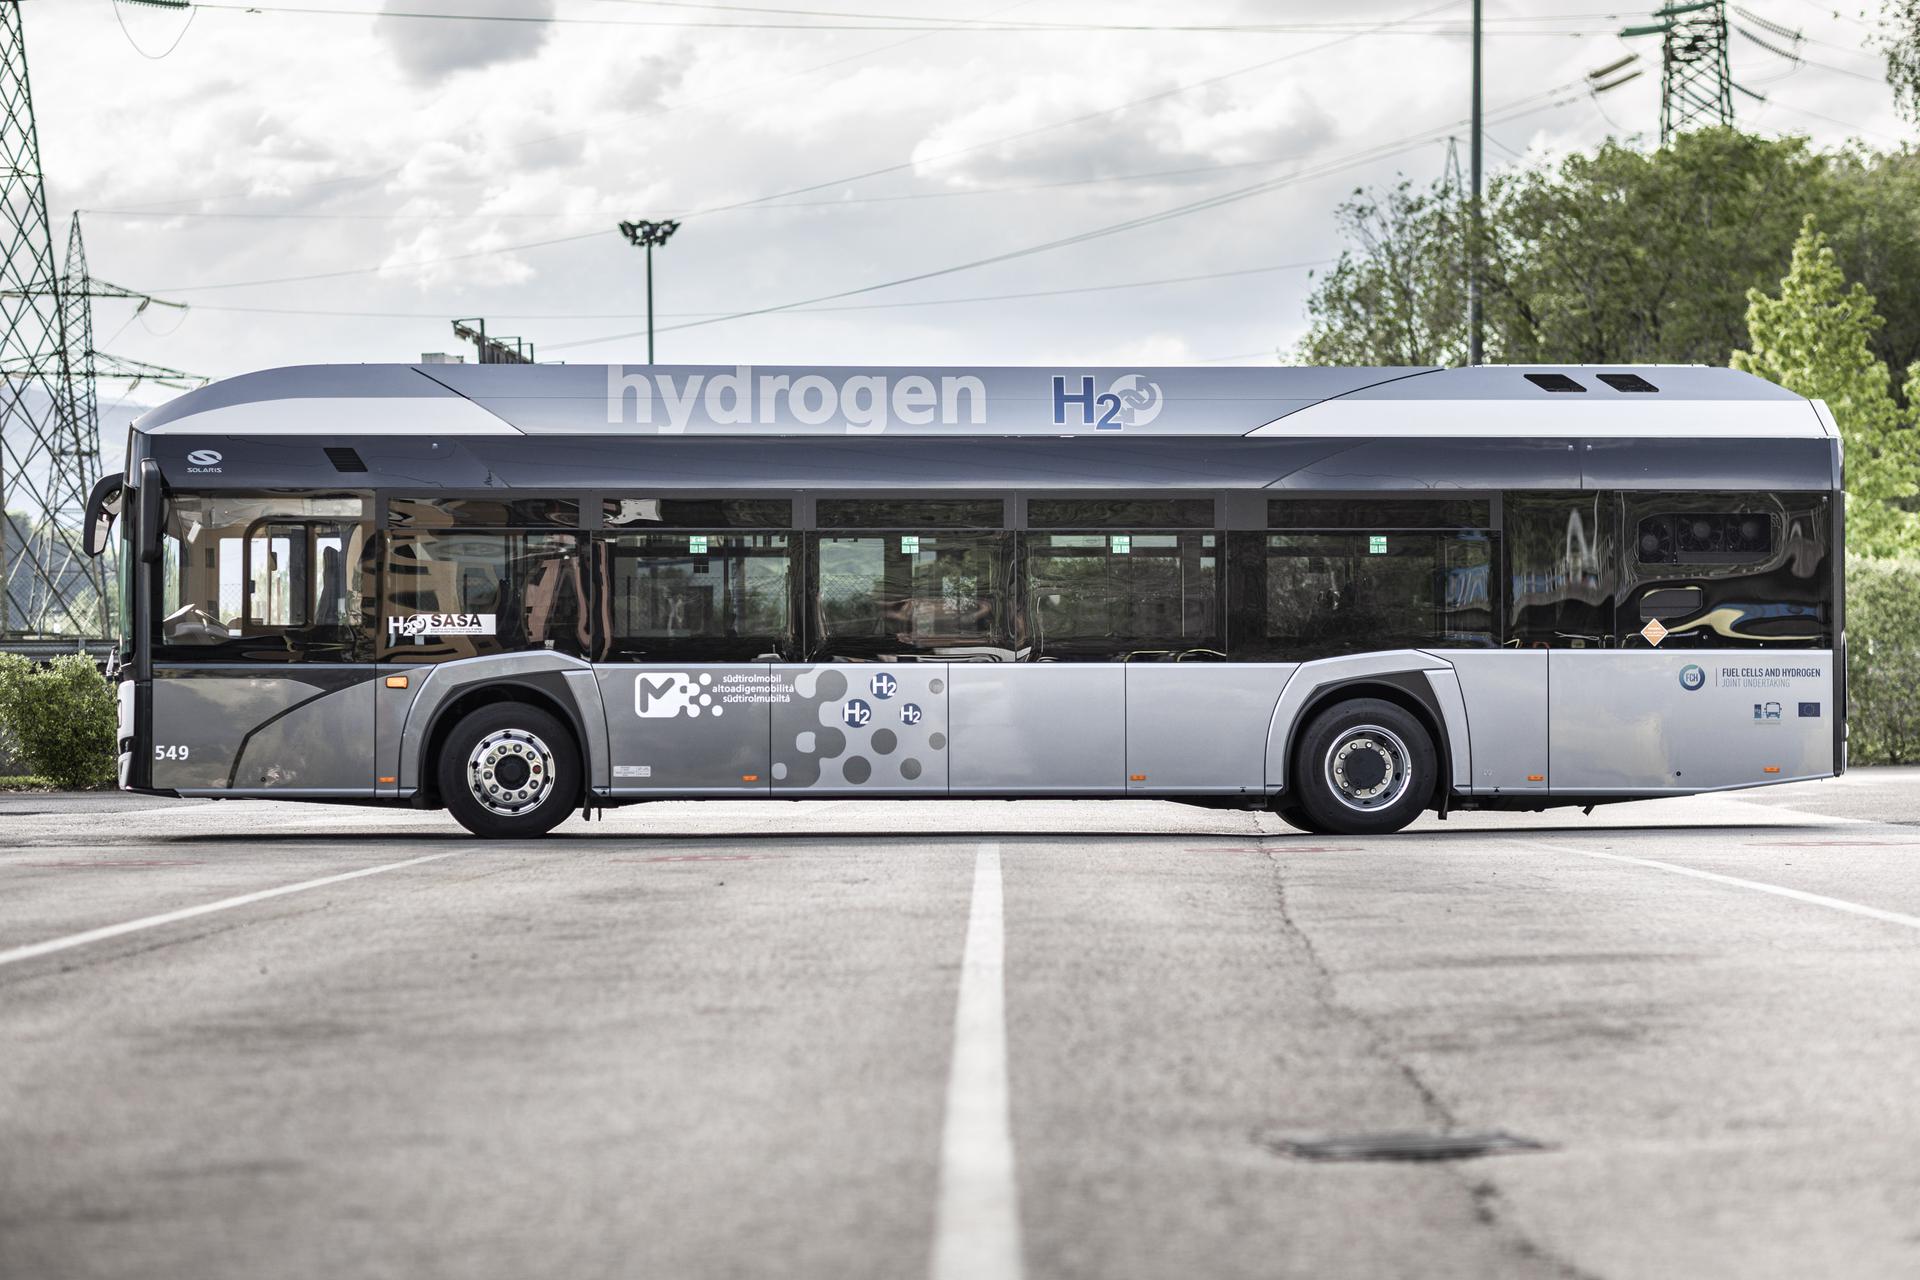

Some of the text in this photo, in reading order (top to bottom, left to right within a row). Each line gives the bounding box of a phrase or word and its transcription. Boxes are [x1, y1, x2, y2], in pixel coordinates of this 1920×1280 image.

[607, 364, 988, 434] hydrogen
[430, 614, 482, 627] SASA
[723, 674, 782, 683] südtirolmobil
[1685, 673, 1699, 682] FCH
[1722, 668, 1821, 678] FUEL CELLS AND HYDROGEN
[872, 675, 897, 697] H2
[1721, 679, 1791, 688] JOINT UNDERTAKING
[844, 702, 871, 725] H2
[901, 706, 921, 723] H2
[155, 745, 189, 760] 549
